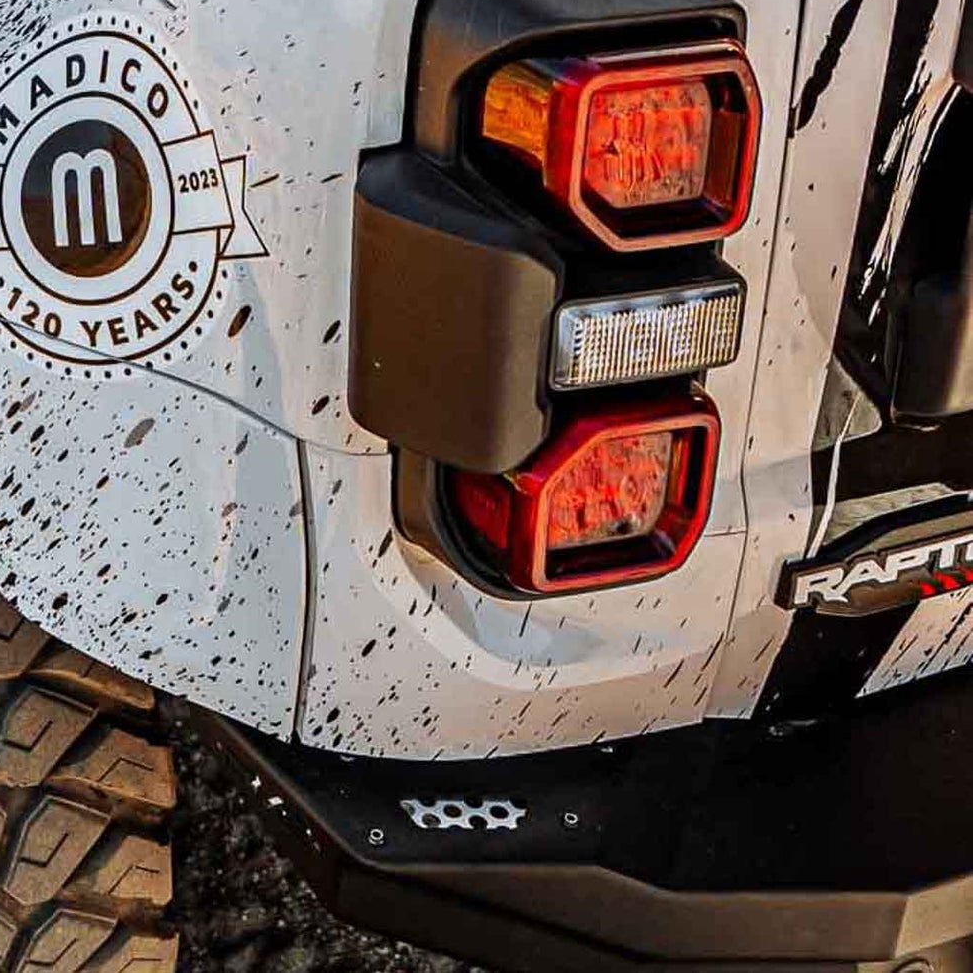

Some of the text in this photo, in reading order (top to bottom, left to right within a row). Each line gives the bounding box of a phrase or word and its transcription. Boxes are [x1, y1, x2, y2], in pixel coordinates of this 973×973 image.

[177, 168, 219, 193] 2023
[6, 273, 194, 348] 120 YEARS
[793, 533, 973, 606] RAPT
